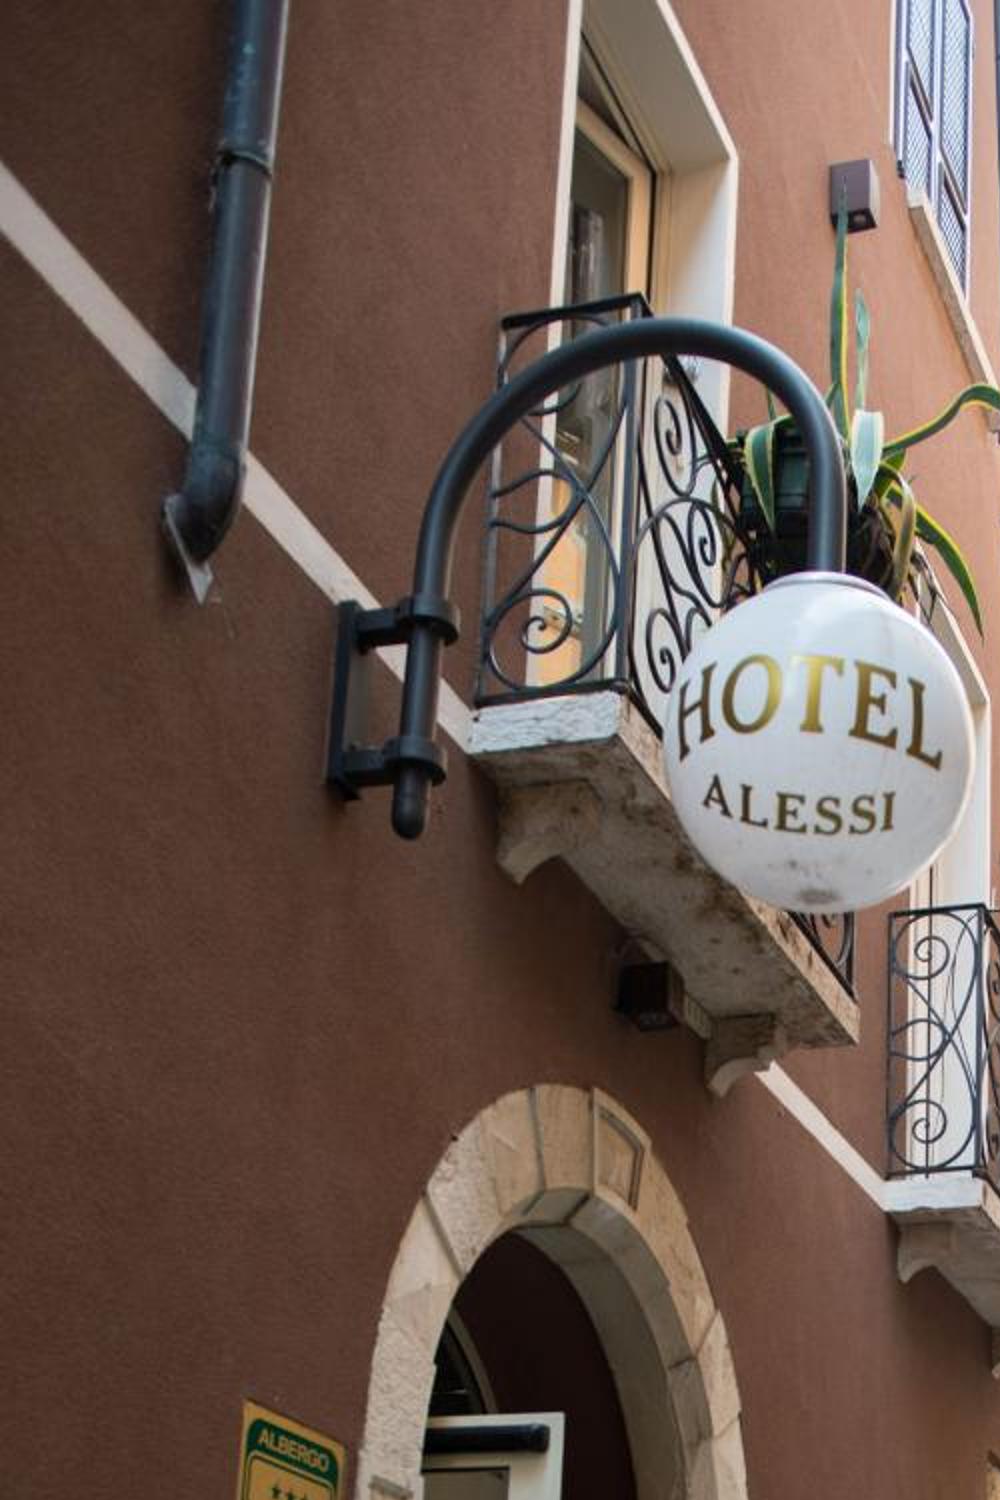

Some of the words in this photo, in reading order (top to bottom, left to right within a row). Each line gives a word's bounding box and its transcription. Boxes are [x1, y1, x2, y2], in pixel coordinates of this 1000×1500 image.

[678, 654, 943, 771] HOTEL
[702, 774, 896, 836] ALESSI
[257, 1428, 330, 1473] ALBERGO
